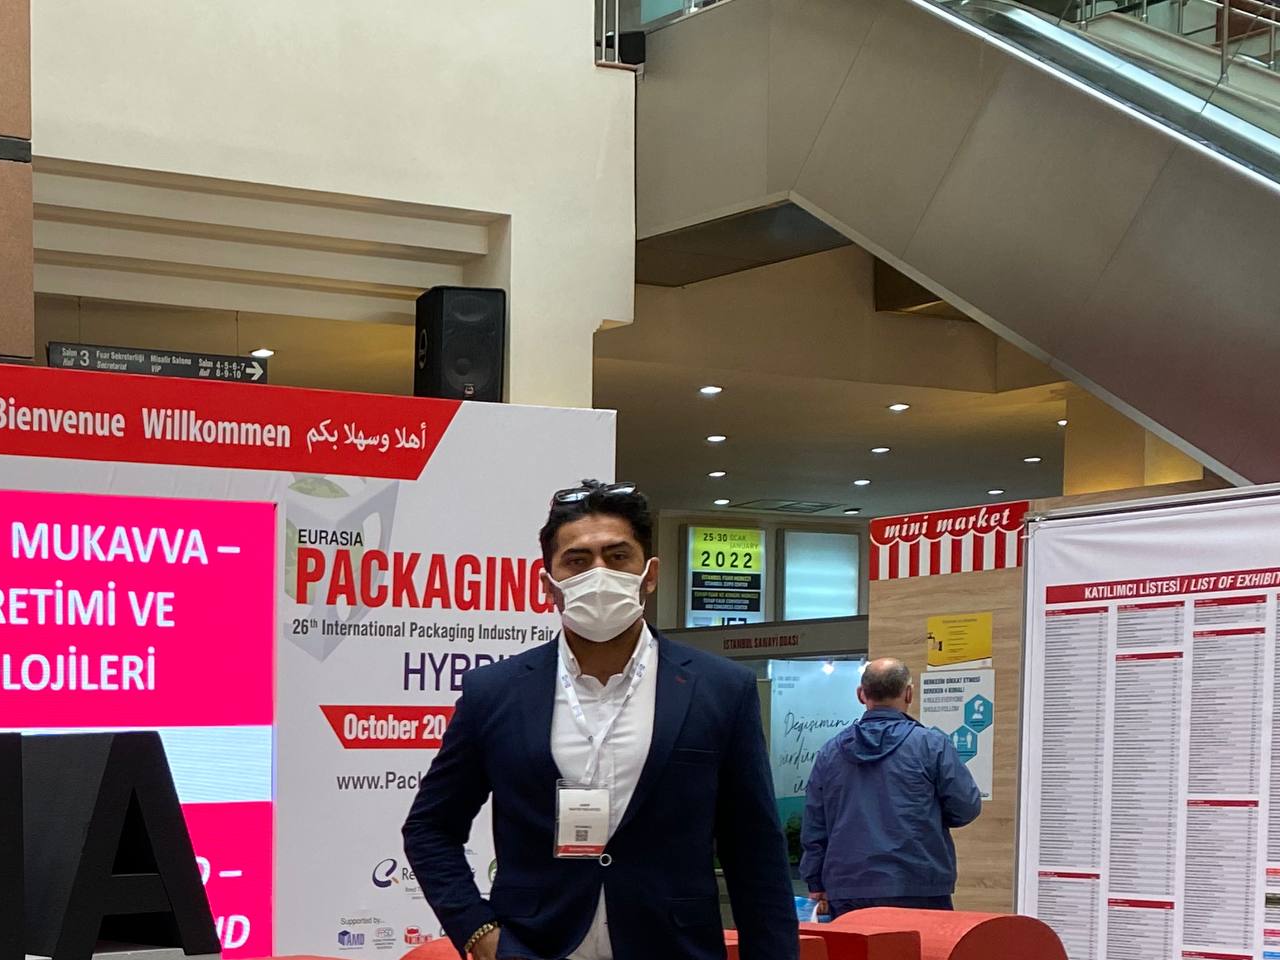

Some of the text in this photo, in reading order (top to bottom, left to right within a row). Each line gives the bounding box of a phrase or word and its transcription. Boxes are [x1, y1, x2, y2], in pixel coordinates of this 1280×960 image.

[79, 350, 90, 367] 3
[141, 407, 291, 448] Willkommen
[884, 506, 1012, 539] mini market
[10, 519, 209, 565] MUKAVVA
[297, 528, 364, 547] EURASIA
[701, 550, 752, 569] 2022
[295, 546, 555, 614] PACKAGING
[1084, 585, 1137, 599] KATILIMCI
[1140, 577, 1180, 595] LİSTESİ
[1190, 576, 1217, 591] LIST
[1218, 576, 1235, 588] OF
[129, 590, 176, 627] VE
[321, 619, 405, 639] International
[409, 621, 476, 644] Packaging
[478, 623, 528, 644] Industry
[530, 624, 555, 641] Fair
[343, 713, 447, 740] October 20
